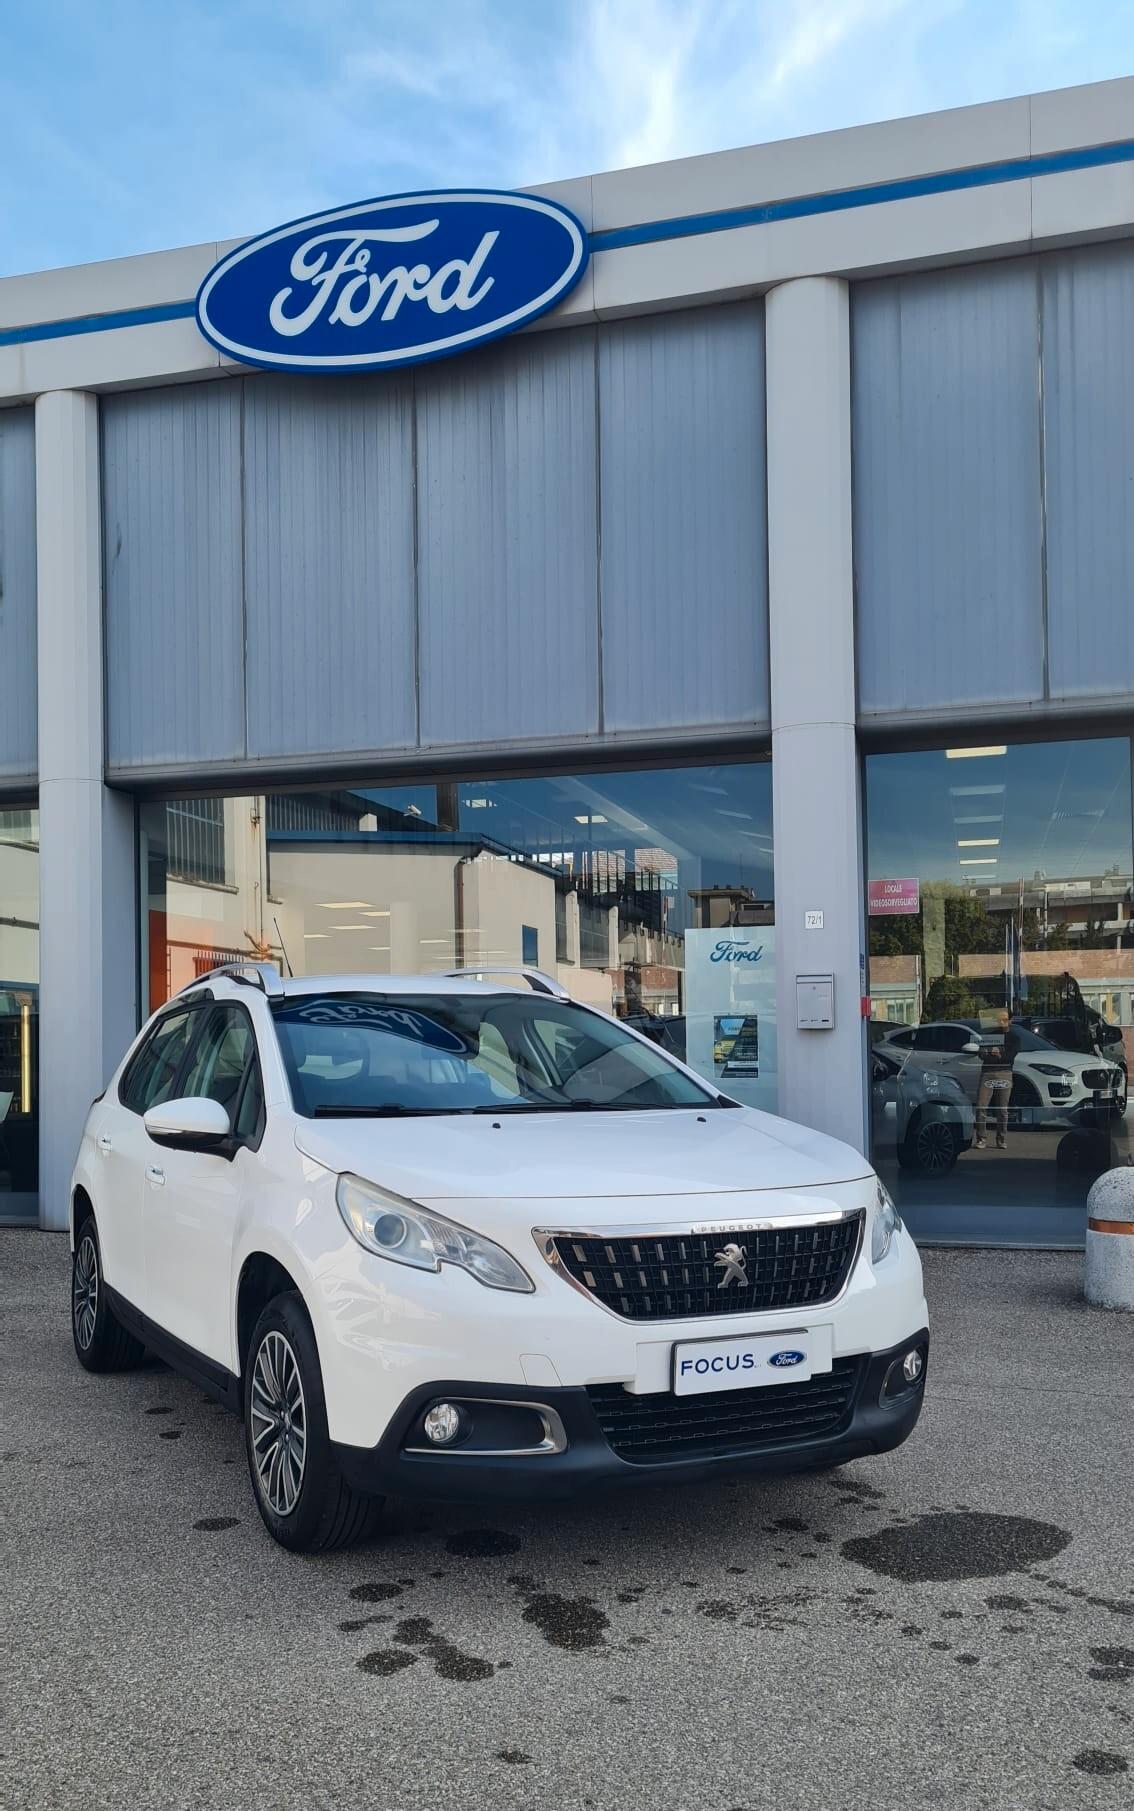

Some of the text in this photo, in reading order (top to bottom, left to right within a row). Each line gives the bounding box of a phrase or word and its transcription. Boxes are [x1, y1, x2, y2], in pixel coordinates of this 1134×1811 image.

[269, 218, 501, 337] Ford
[710, 940, 763, 962] Ford
[701, 1223, 762, 1233] PEUGEOT
[681, 1353, 755, 1376] FOCUS
